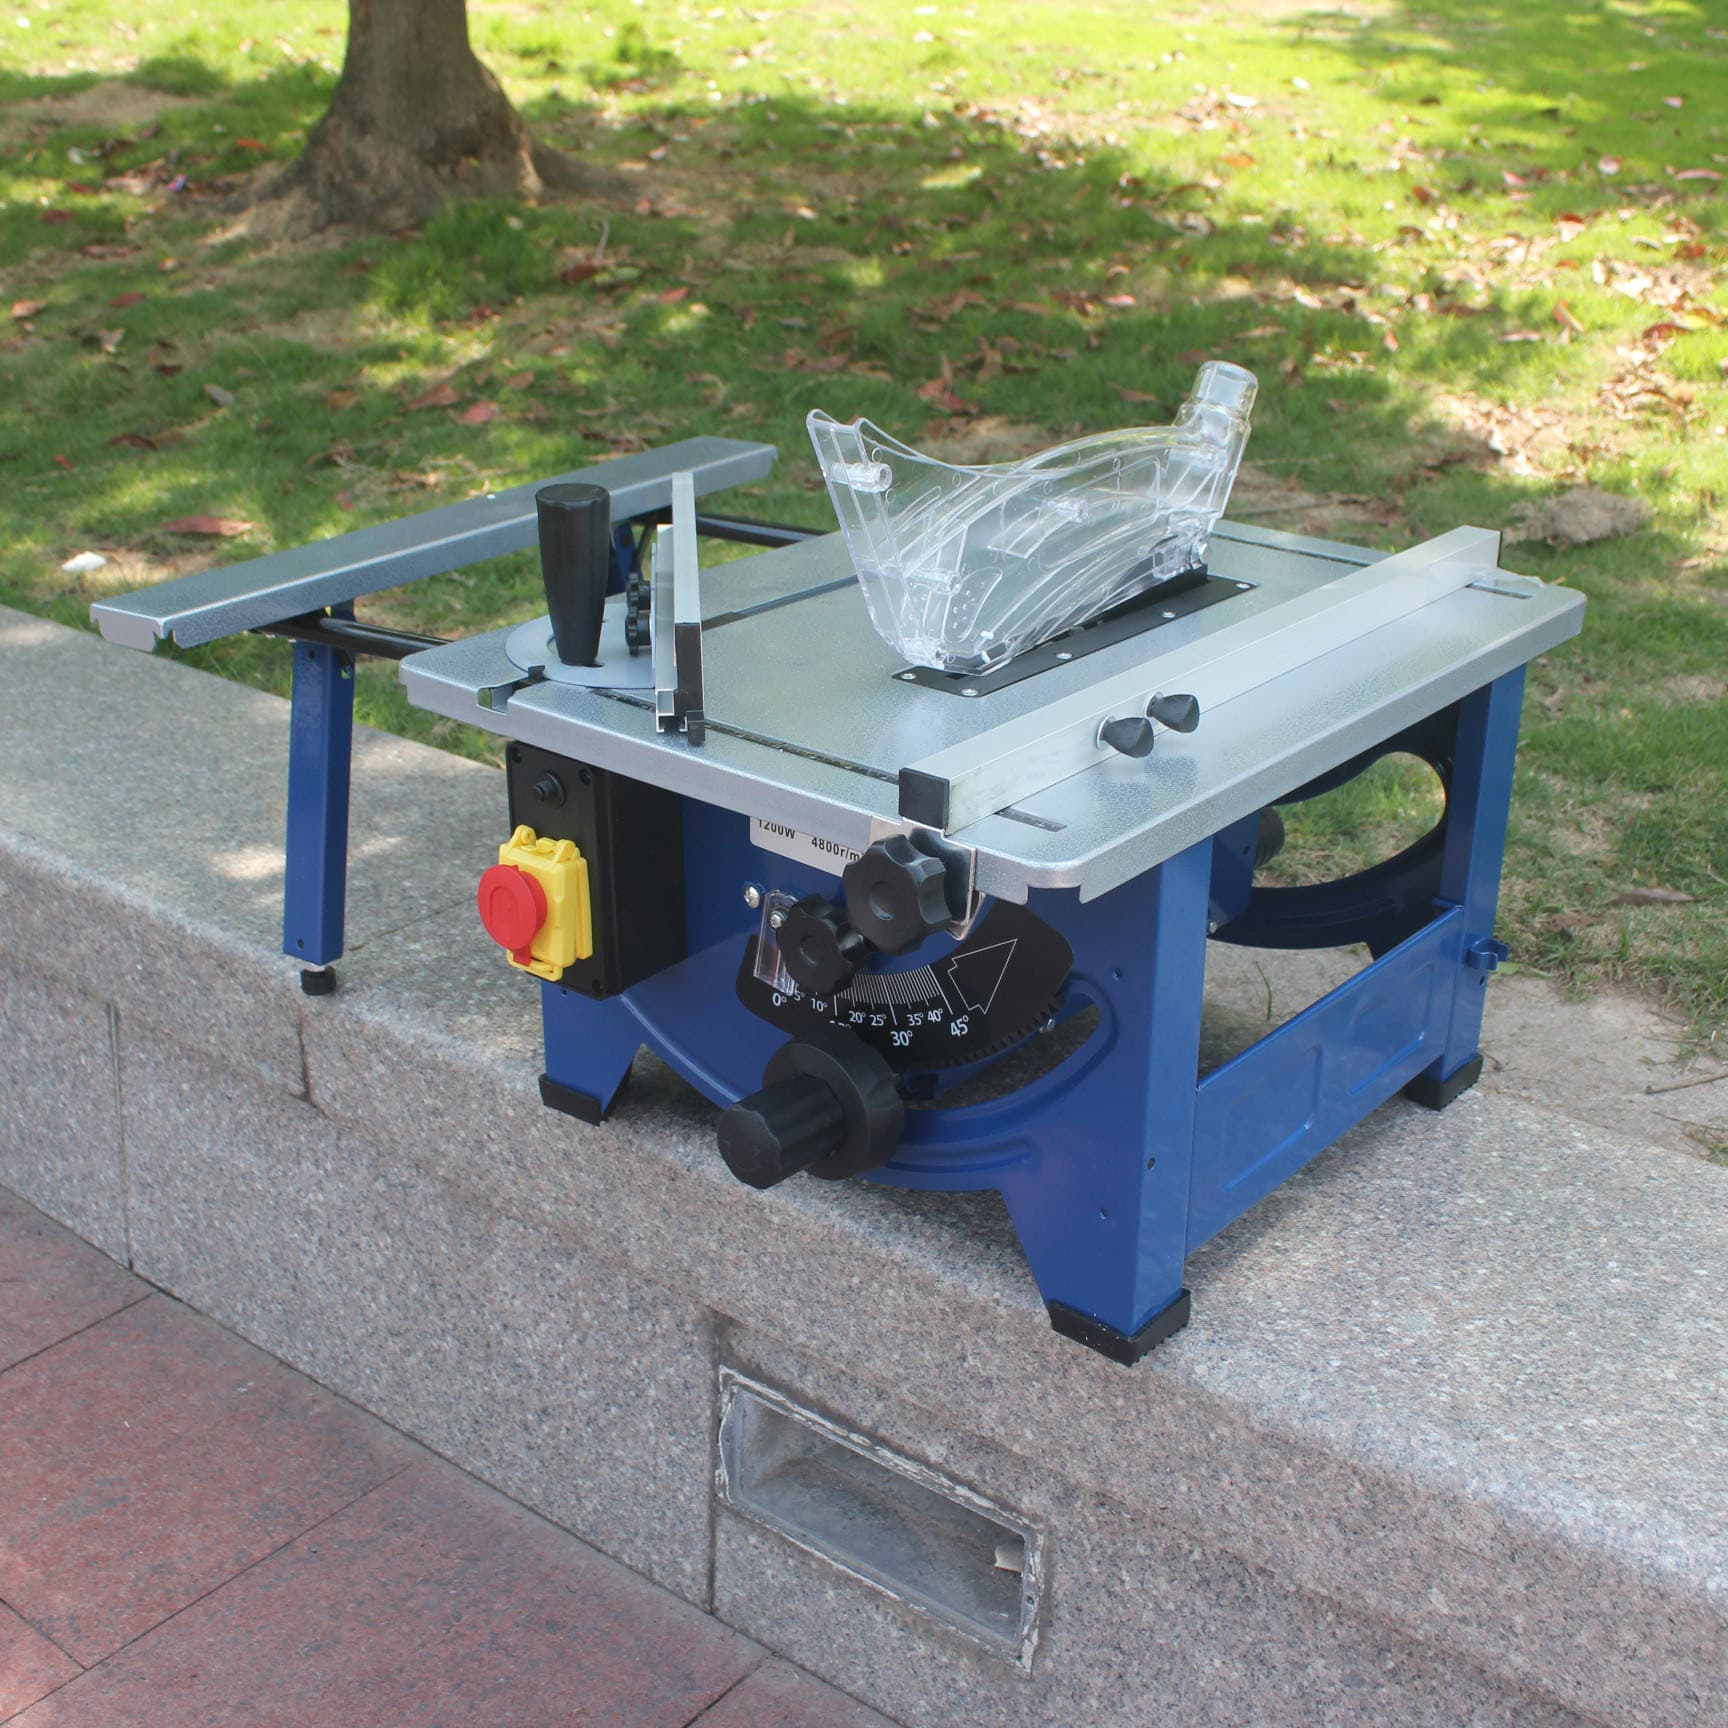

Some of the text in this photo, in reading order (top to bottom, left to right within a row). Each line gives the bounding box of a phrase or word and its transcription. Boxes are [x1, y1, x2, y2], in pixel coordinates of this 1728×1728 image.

[757, 819, 864, 861] 1200W 4800r/m
[848, 1010, 866, 1023] 20°
[869, 1013, 887, 1026] 25°
[890, 1030, 913, 1046] 30°
[906, 1012, 924, 1026] 35°
[927, 1008, 944, 1022] 40°
[950, 1015, 969, 1037] 45°
